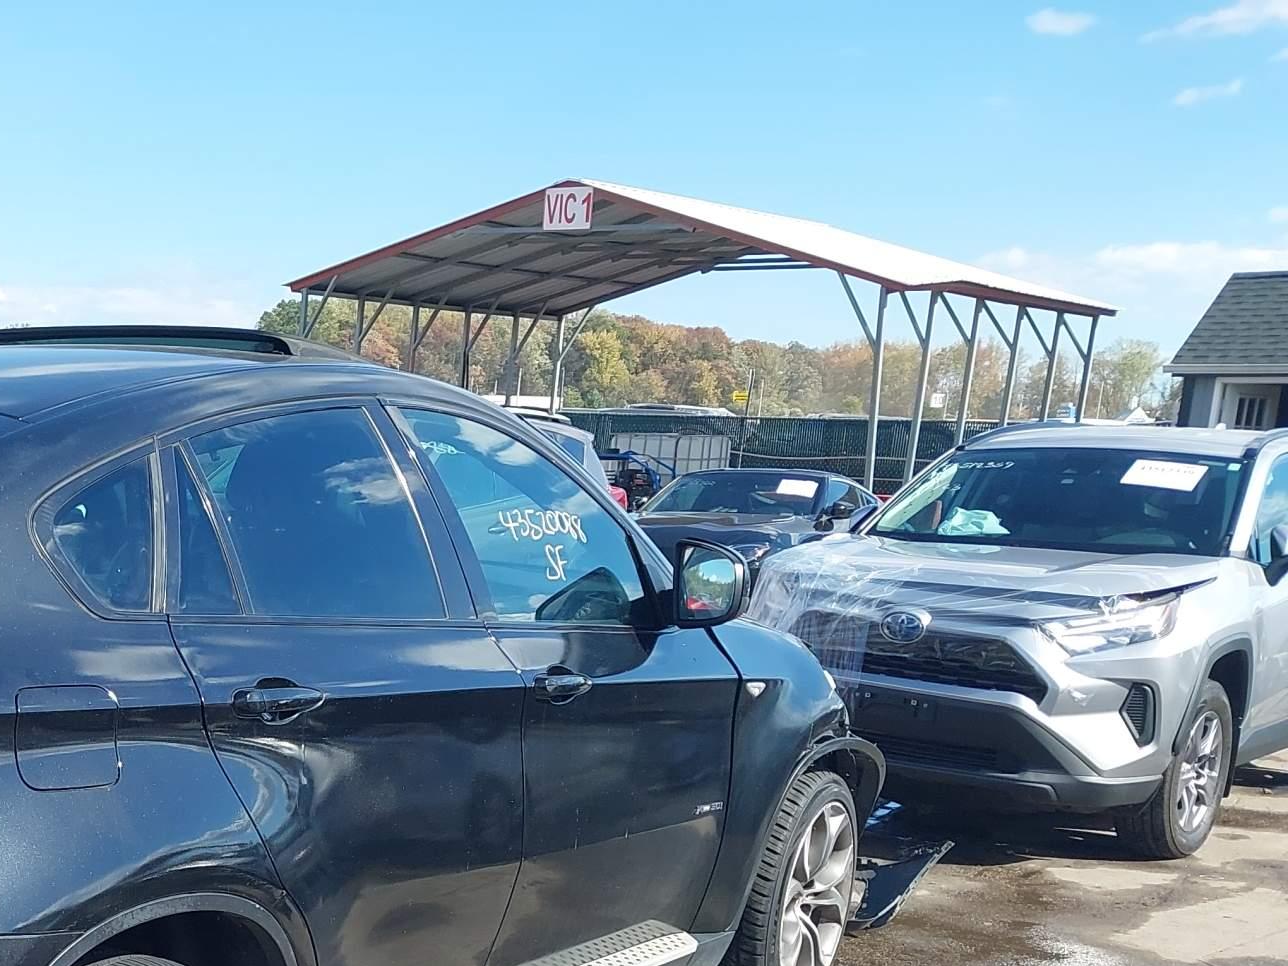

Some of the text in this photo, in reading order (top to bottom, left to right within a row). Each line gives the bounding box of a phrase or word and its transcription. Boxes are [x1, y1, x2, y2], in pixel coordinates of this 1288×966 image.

[547, 191, 592, 225] VIC 1
[545, 544, 568, 581] SF
